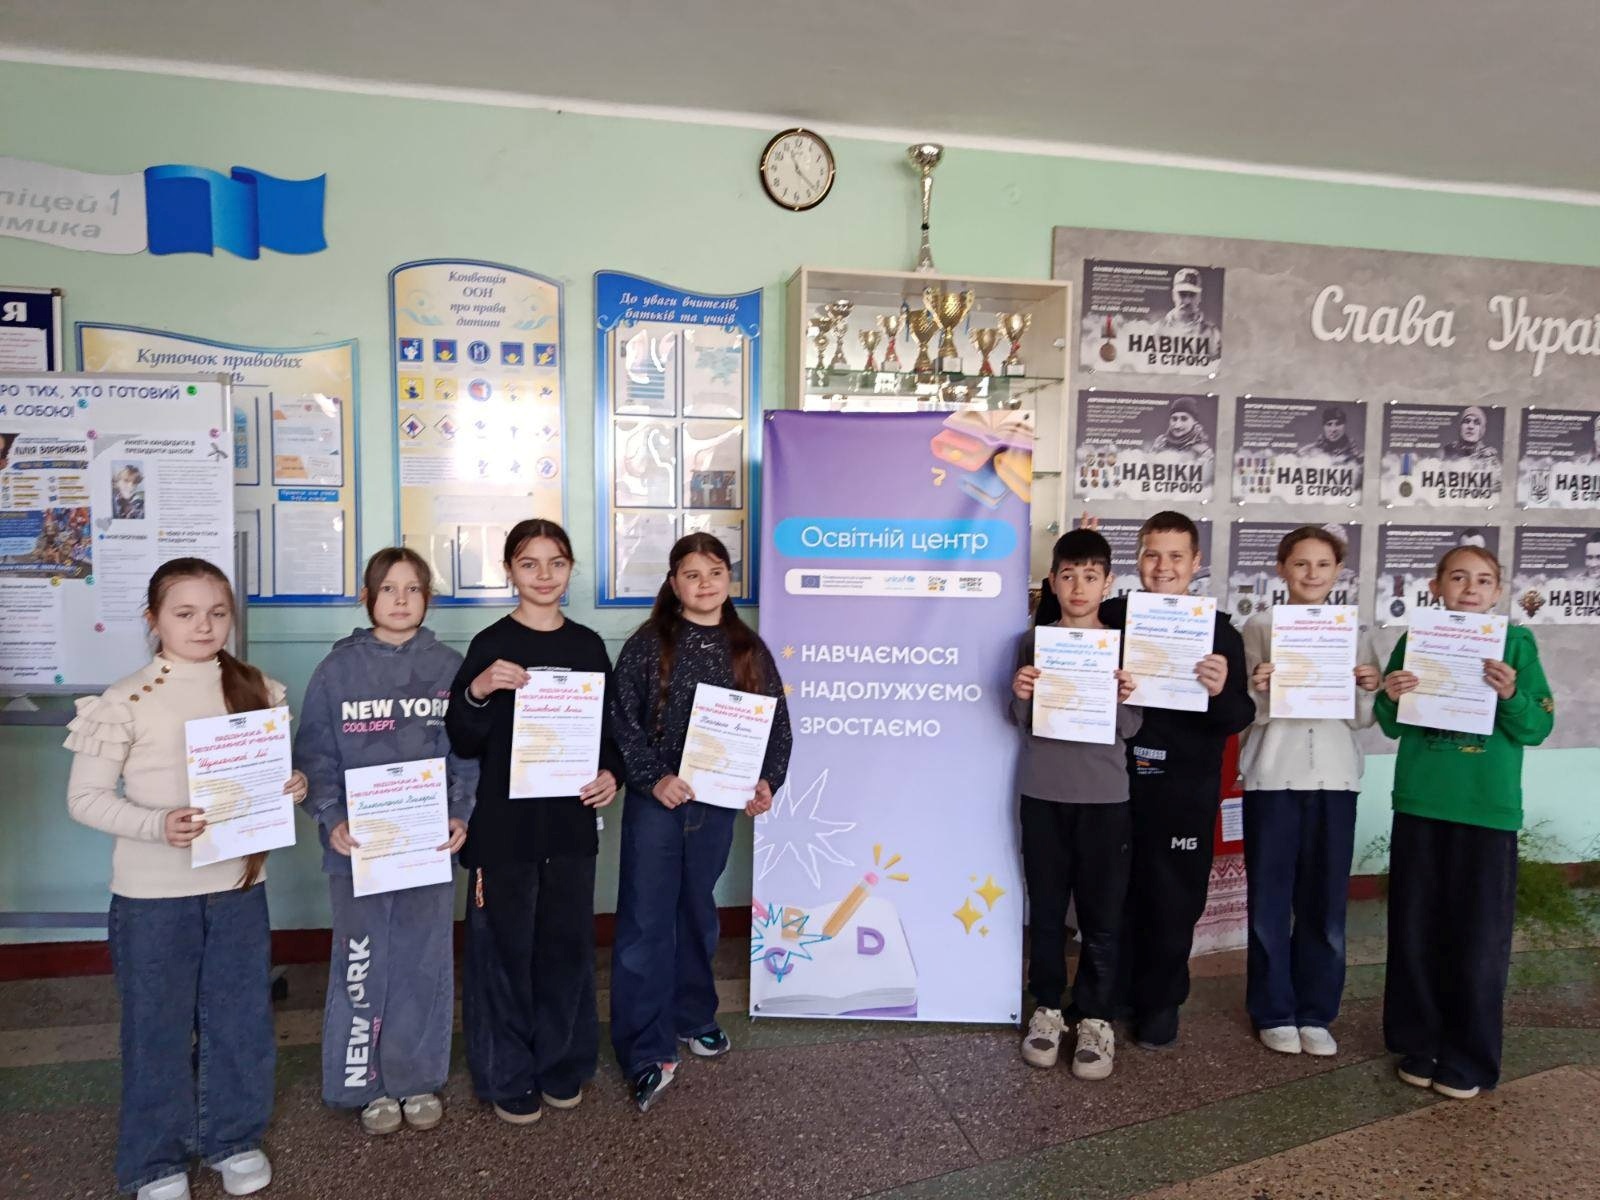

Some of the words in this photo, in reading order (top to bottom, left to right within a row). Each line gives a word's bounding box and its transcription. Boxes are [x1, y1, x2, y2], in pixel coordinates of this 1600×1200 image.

[110, 189, 120, 216] 1
[448, 271, 507, 285] Конвенція
[462, 287, 493, 298] ООН
[619, 292, 637, 305] До
[643, 294, 677, 308] уваги
[450, 303, 471, 313] про
[473, 302, 507, 315] права
[625, 307, 675, 321] батьків
[680, 313, 698, 322] та
[703, 313, 736, 325] учнів
[1311, 284, 1457, 348] Слава
[456, 317, 501, 328] дитини
[1128, 334, 1210, 355] НАВІКИ
[137, 348, 218, 371] Куточок
[222, 351, 303, 372] правових
[1148, 354, 1157, 365] В
[1161, 355, 1210, 367] СТРОЮ
[71, 386, 103, 398] ХТО
[108, 385, 180, 400] ГОТОВИЙ
[1122, 463, 1203, 482] НАВІКИ
[1277, 467, 1353, 485] НАВІКИ
[1421, 471, 1492, 488] НАВІКИ
[1142, 482, 1150, 492] В
[1153, 483, 1203, 494] СТРОЮ
[1555, 474, 1600, 490] НАВІ
[1295, 486, 1304, 495] В
[1307, 486, 1352, 497] СТРОЮ
[1438, 488, 1446, 498] В
[1449, 489, 1491, 499] СТРОЮ
[1571, 491, 1578, 501] В
[801, 525, 905, 549] Освітній
[911, 530, 989, 554] центр
[1565, 606, 1572, 616] В
[801, 644, 959, 665] НАВЧАЄМОСЯ
[800, 681, 983, 702] НАДОЛУЖУЄМО
[342, 700, 394, 720] NEW
[343, 721, 368, 733] COOL
[800, 716, 941, 738] ЗРОСТАЄМО
[1171, 837, 1198, 850] MG
[857, 926, 885, 955] D
[344, 1016, 370, 1087] NEW
